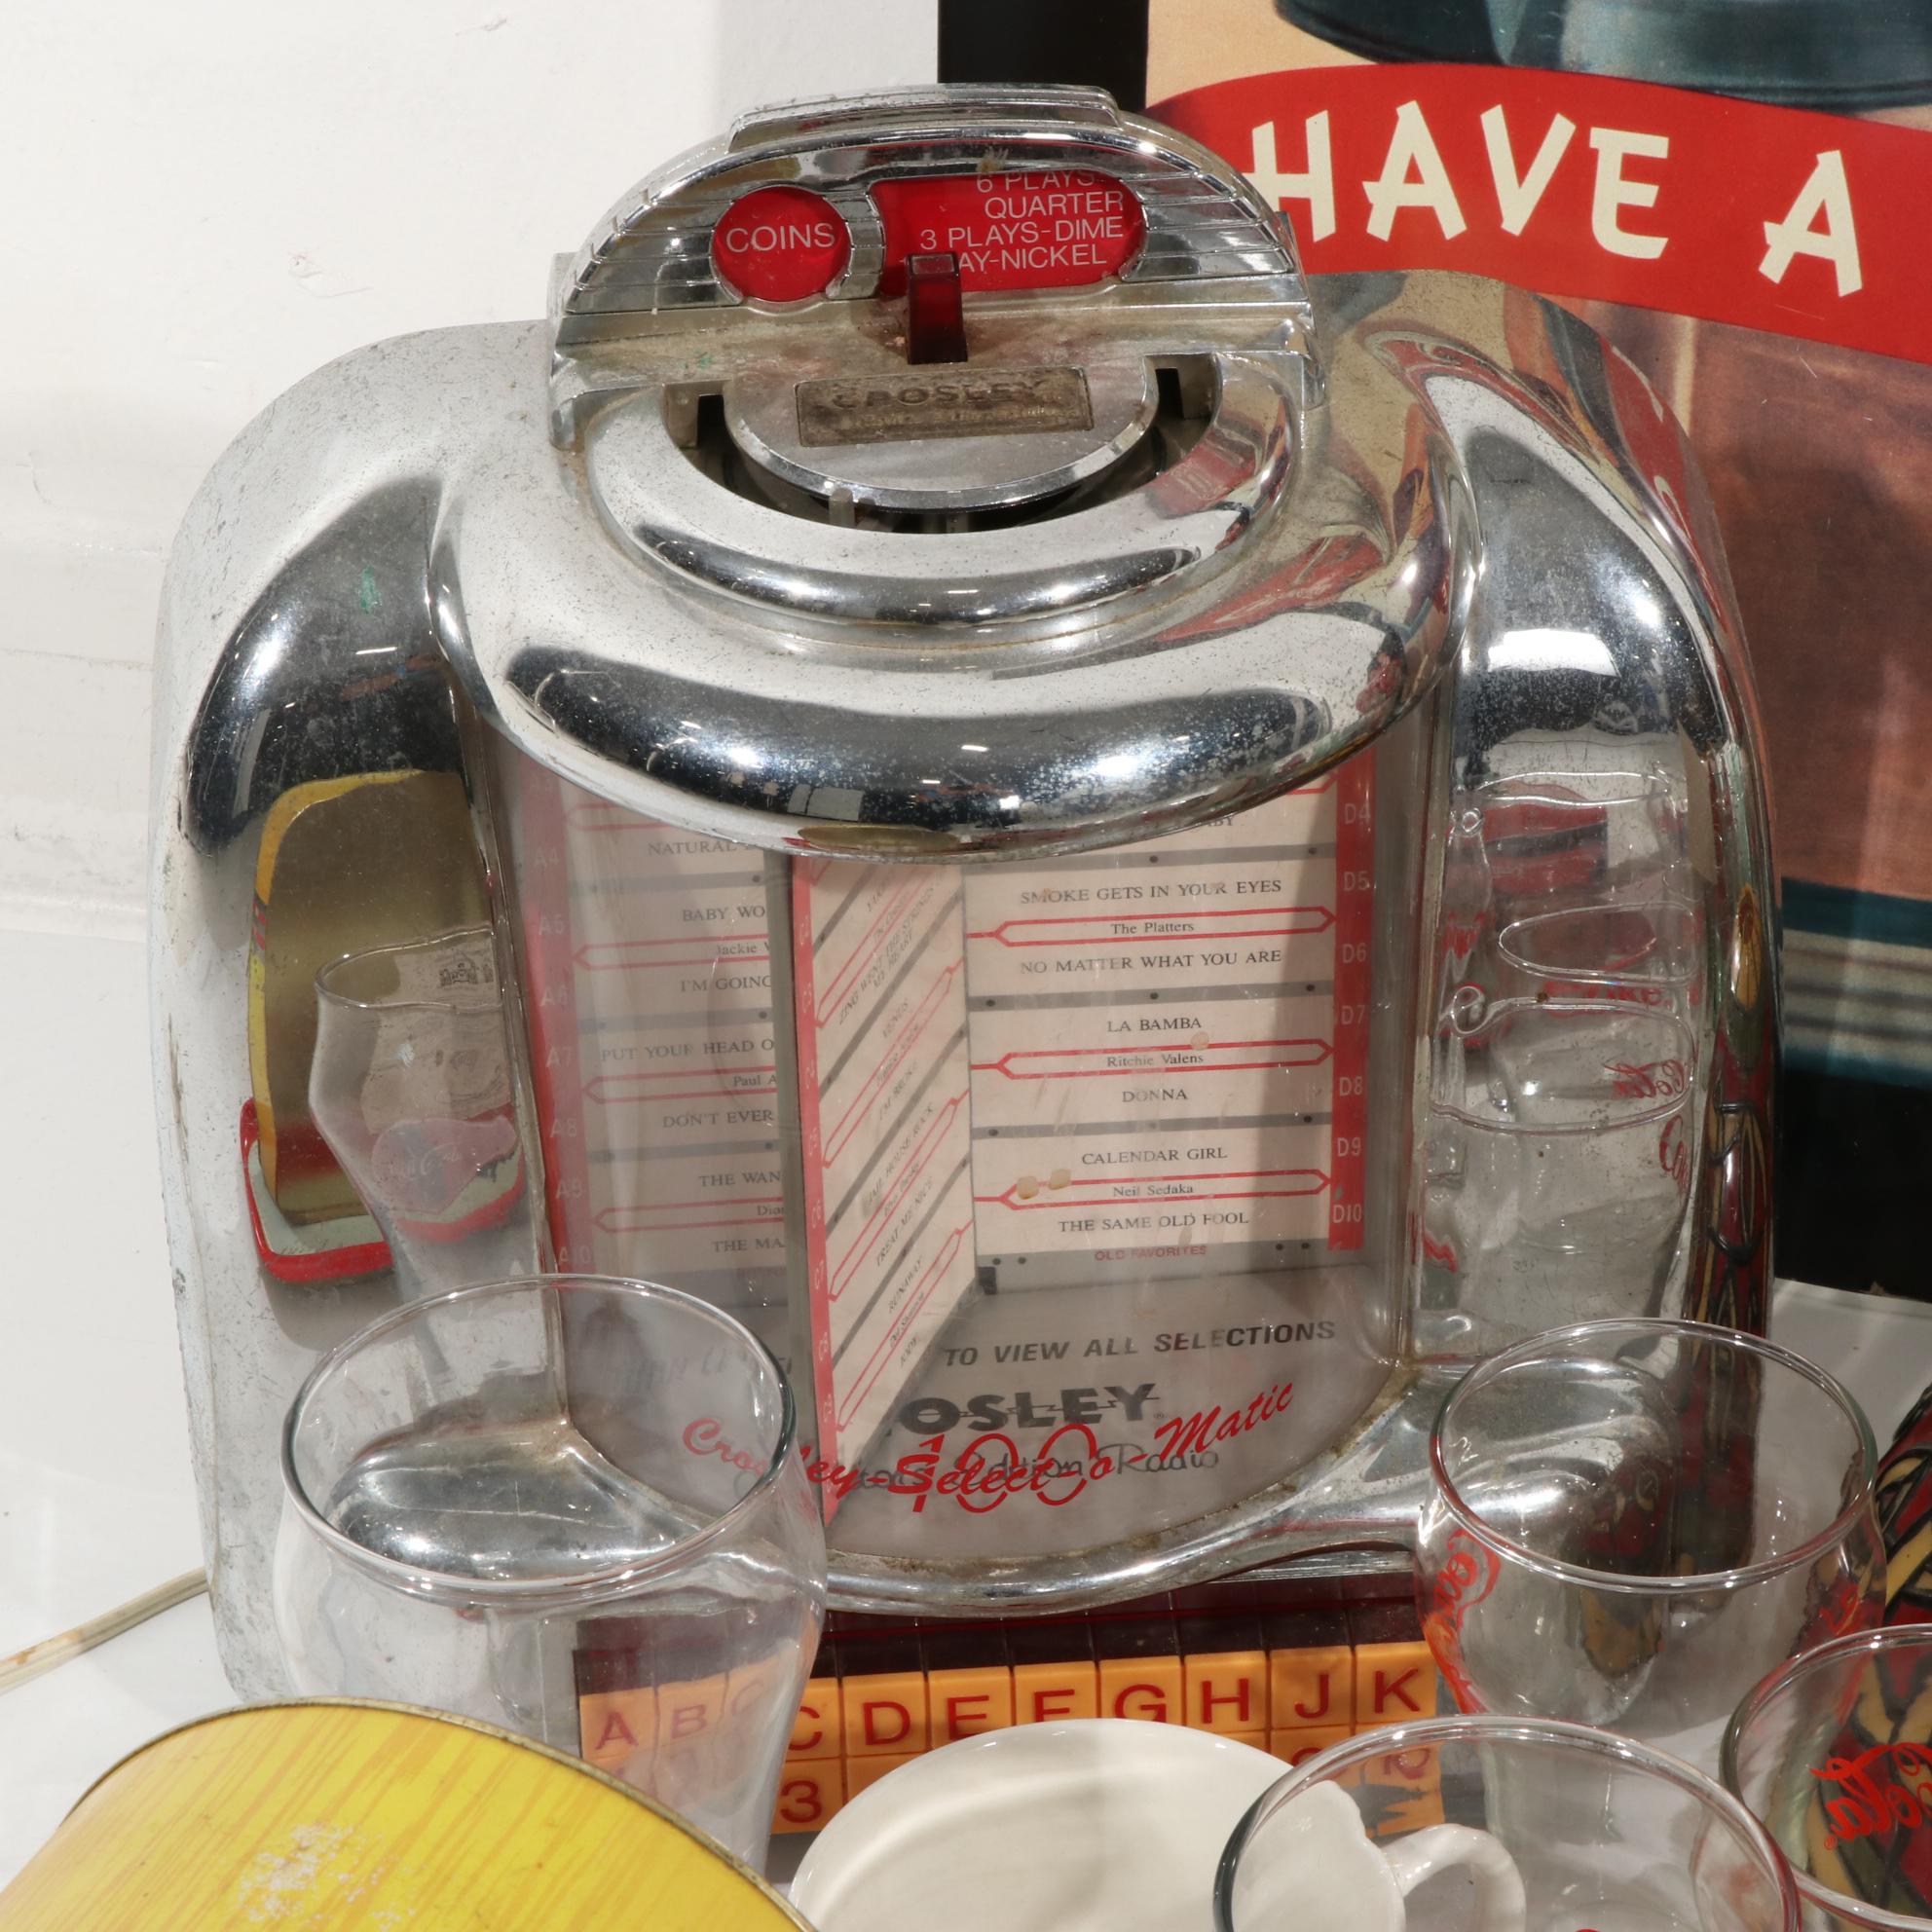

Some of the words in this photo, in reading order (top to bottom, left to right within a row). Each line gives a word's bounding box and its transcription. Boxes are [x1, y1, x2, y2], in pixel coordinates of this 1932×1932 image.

[977, 172, 993, 194] 6
[985, 190, 1124, 220] QUARTER
[1242, 99, 1670, 260] HAVE
[1759, 149, 1863, 298] A
[725, 223, 836, 253] COINS
[920, 230, 937, 250] 3
[948, 216, 1124, 248] PLAYS-DIME
[958, 243, 1107, 274] AY-NICKEL
[1020, 887, 1090, 905] SMOKE
[1096, 884, 1143, 902] GETS
[1149, 883, 1170, 899] IN
[1177, 881, 1227, 898] YOUR
[1236, 878, 1282, 895] EYES
[1344, 871, 1369, 892] D5
[683, 907, 729, 923] BABY
[1110, 921, 1137, 936] The
[1144, 919, 1195, 935] Platters
[1020, 960, 1048, 976] NO
[1055, 955, 1133, 973] MATTER
[1140, 953, 1194, 970] WHAT
[1201, 950, 1239, 967] YOU
[1245, 948, 1282, 965] ARE
[1342, 943, 1367, 964] D6
[680, 977, 709, 993] I'M
[1107, 1019, 1132, 1033] LA
[1138, 1017, 1203, 1032] BAMBA
[1340, 1004, 1366, 1026] D7
[703, 1040, 756, 1056] HEAD
[1106, 1053, 1155, 1068] Ritchie
[1162, 1052, 1205, 1067] Valens
[733, 1075, 762, 1089] Paul
[1338, 1076, 1364, 1097] D8
[1122, 1088, 1188, 1104] DONNA
[662, 1113, 722, 1130] DON'T
[726, 1108, 774, 1125] EVER
[1081, 1148, 1179, 1166] CALENDAR
[1186, 1145, 1230, 1162] GIRL
[1336, 1135, 1363, 1158] D9
[698, 1171, 736, 1188] THE
[1112, 1184, 1139, 1198] Neil
[1147, 1181, 1194, 1196] Sedaka
[1059, 1218, 1096, 1234] THE
[1102, 1215, 1151, 1232] SAME
[1158, 1213, 1197, 1229] OLD
[1203, 1210, 1250, 1227] FOOL
[1332, 1202, 1362, 1224] D10
[712, 1240, 749, 1254] THE
[944, 1346, 980, 1368] TO
[993, 1339, 1075, 1364] VIEW
[1084, 1334, 1138, 1357] ALL
[1154, 1319, 1336, 1354] SELECTIONS
[898, 1382, 1161, 1435] OSLEY
[595, 1711, 639, 1751] A
[671, 1703, 708, 1740] B
[862, 1700, 912, 1746] D
[946, 1694, 990, 1741] E
[1114, 1684, 1167, 1723] G
[1202, 1678, 1250, 1725] H
[1294, 1673, 1329, 1719] J
[1374, 1668, 1421, 1715] K
[780, 1779, 823, 1824] 3
